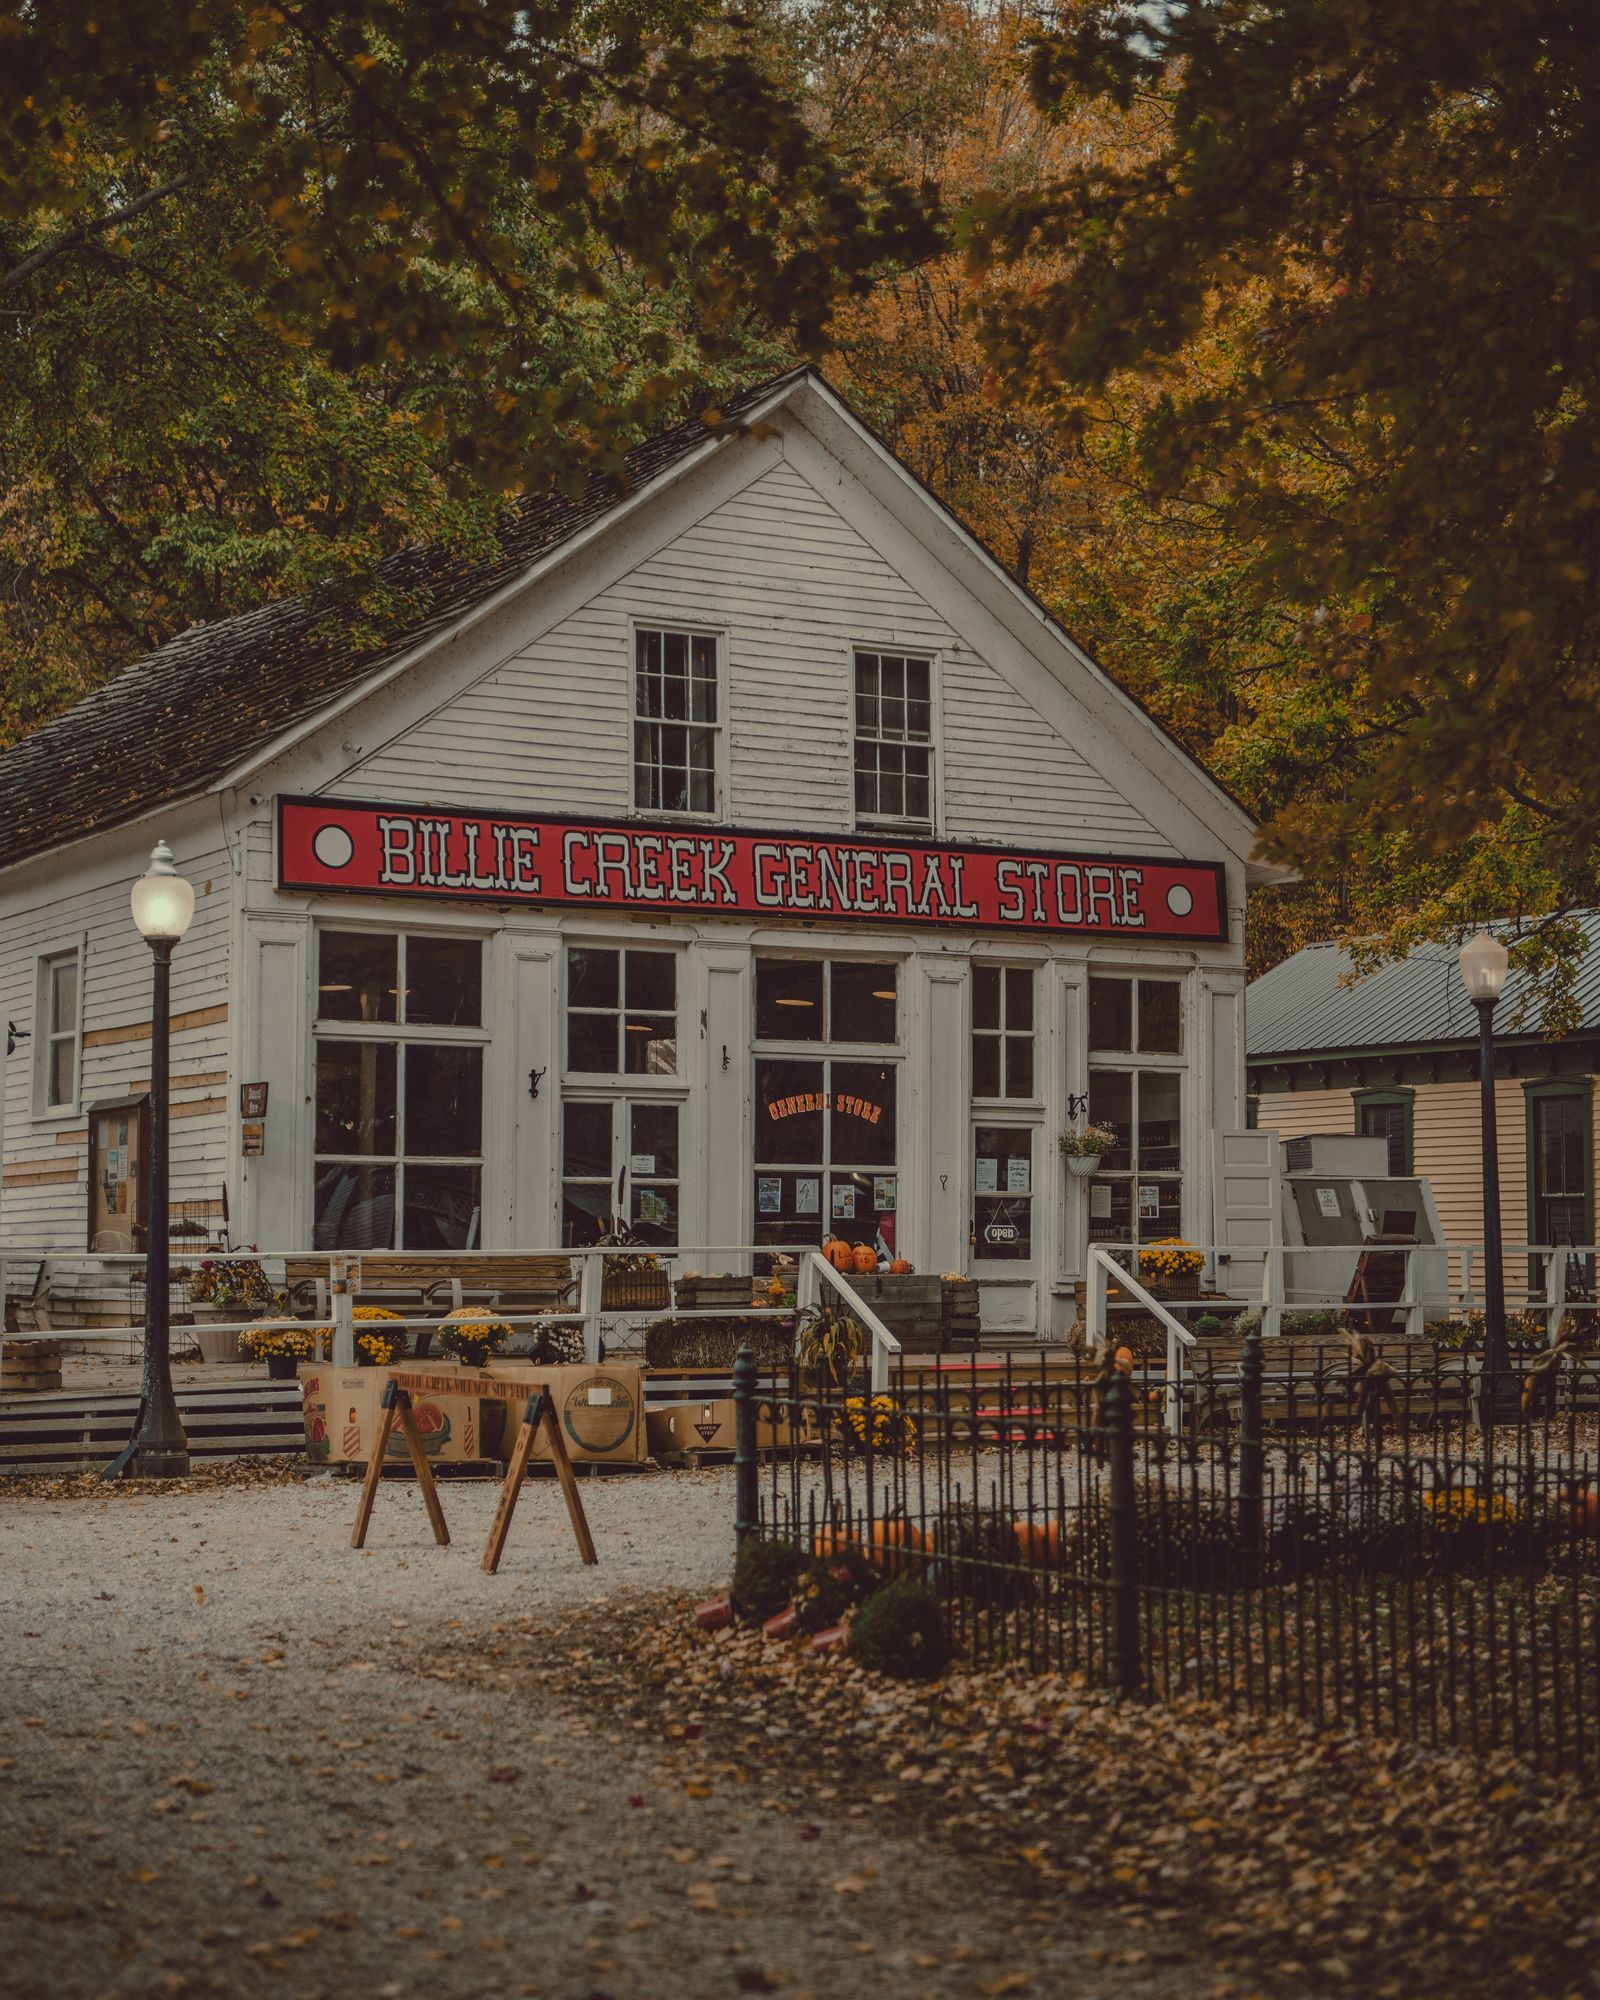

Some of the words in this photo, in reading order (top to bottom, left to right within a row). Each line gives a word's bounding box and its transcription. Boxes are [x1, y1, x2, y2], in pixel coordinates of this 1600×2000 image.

[378, 817, 540, 892] BILLIE
[563, 831, 737, 903] CREEK
[753, 844, 978, 918] GENERAL
[997, 861, 1144, 926] STORE
[837, 1094, 881, 1123] STORE
[991, 1228, 1014, 1241] open
[400, 1373, 423, 1388] BILLIE
[426, 1376, 455, 1392] CREEK
[455, 1379, 488, 1395] VILLAGE
